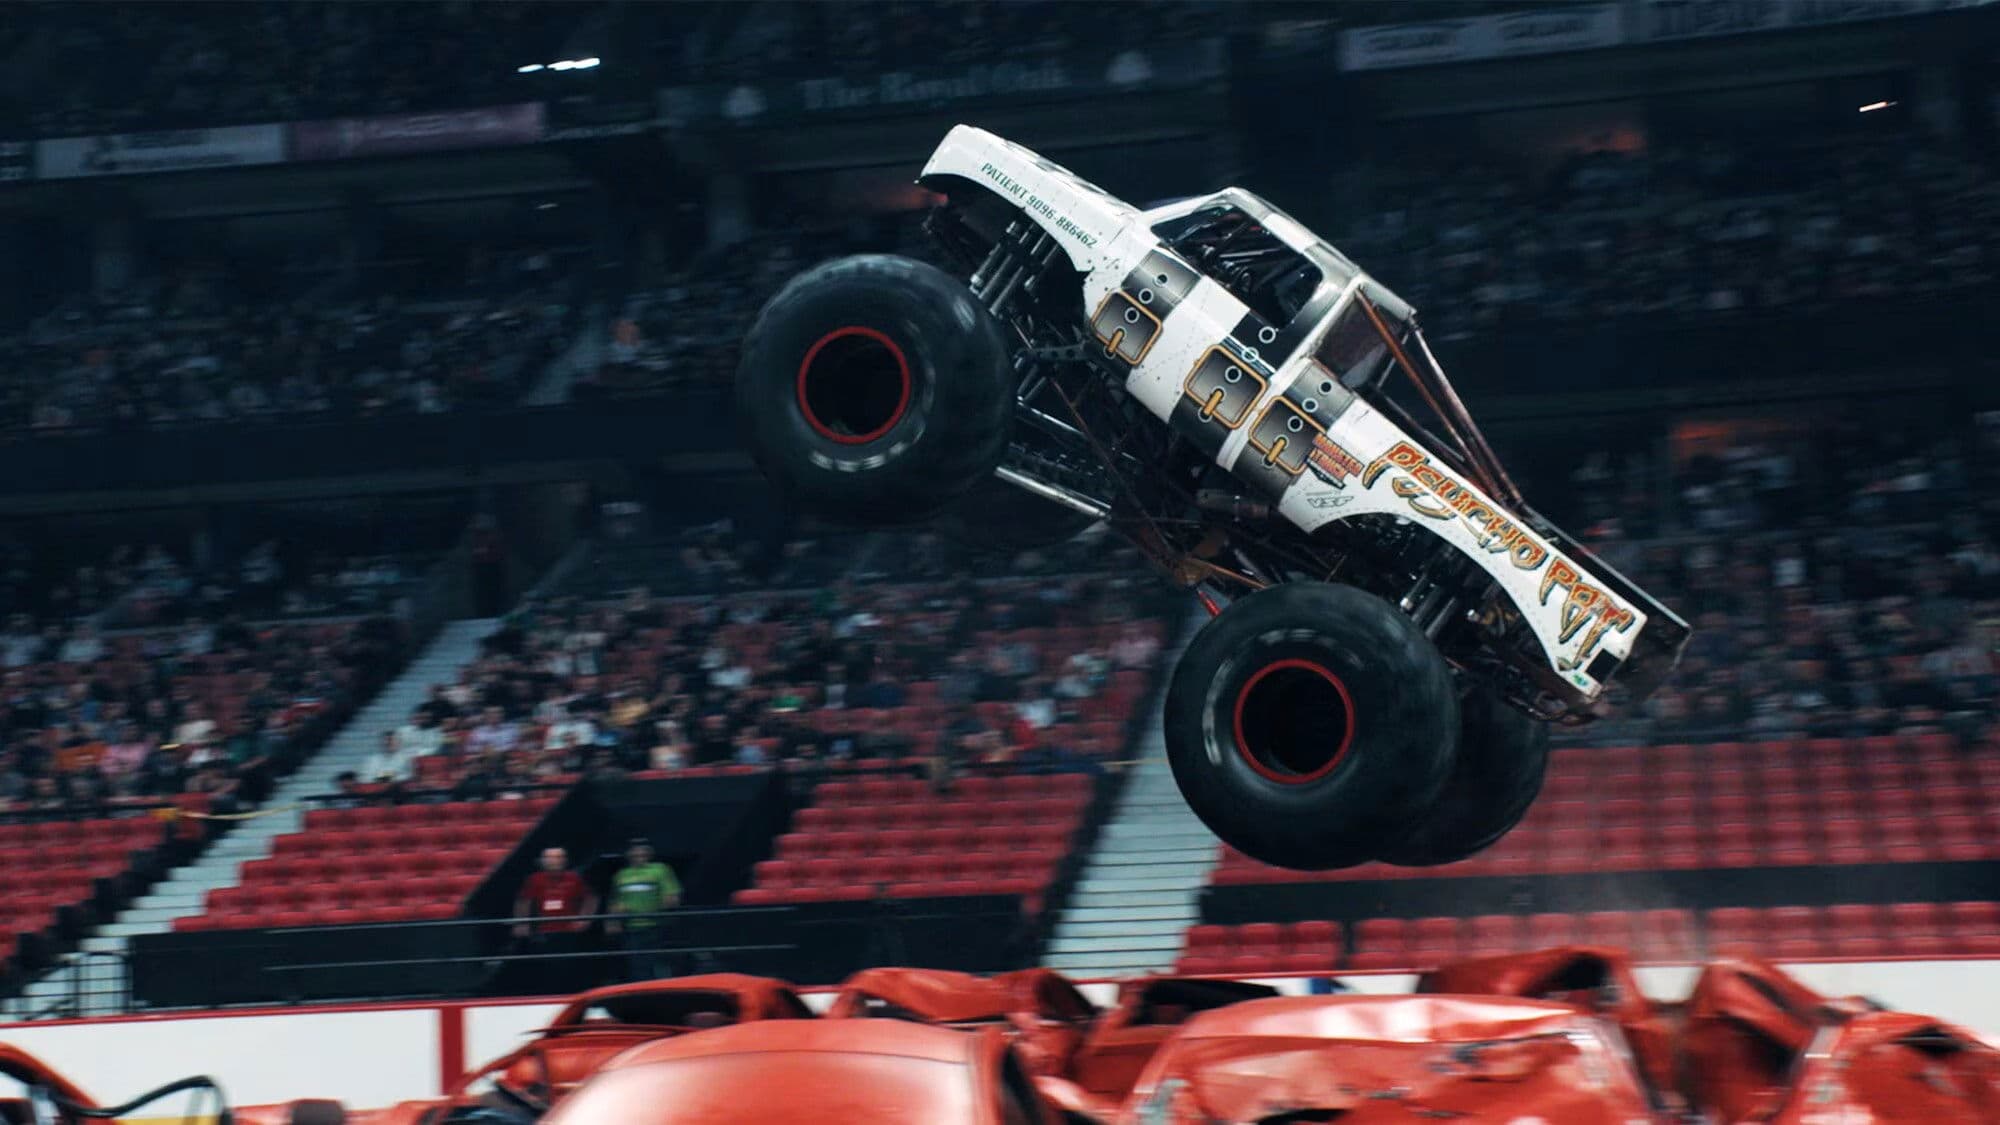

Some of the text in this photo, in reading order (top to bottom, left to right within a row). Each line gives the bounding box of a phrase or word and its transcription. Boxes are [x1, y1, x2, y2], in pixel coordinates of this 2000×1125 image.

[981, 162, 1098, 248] PATIENT 9096-886462
[1362, 441, 1636, 671] PSYCHO PAT
